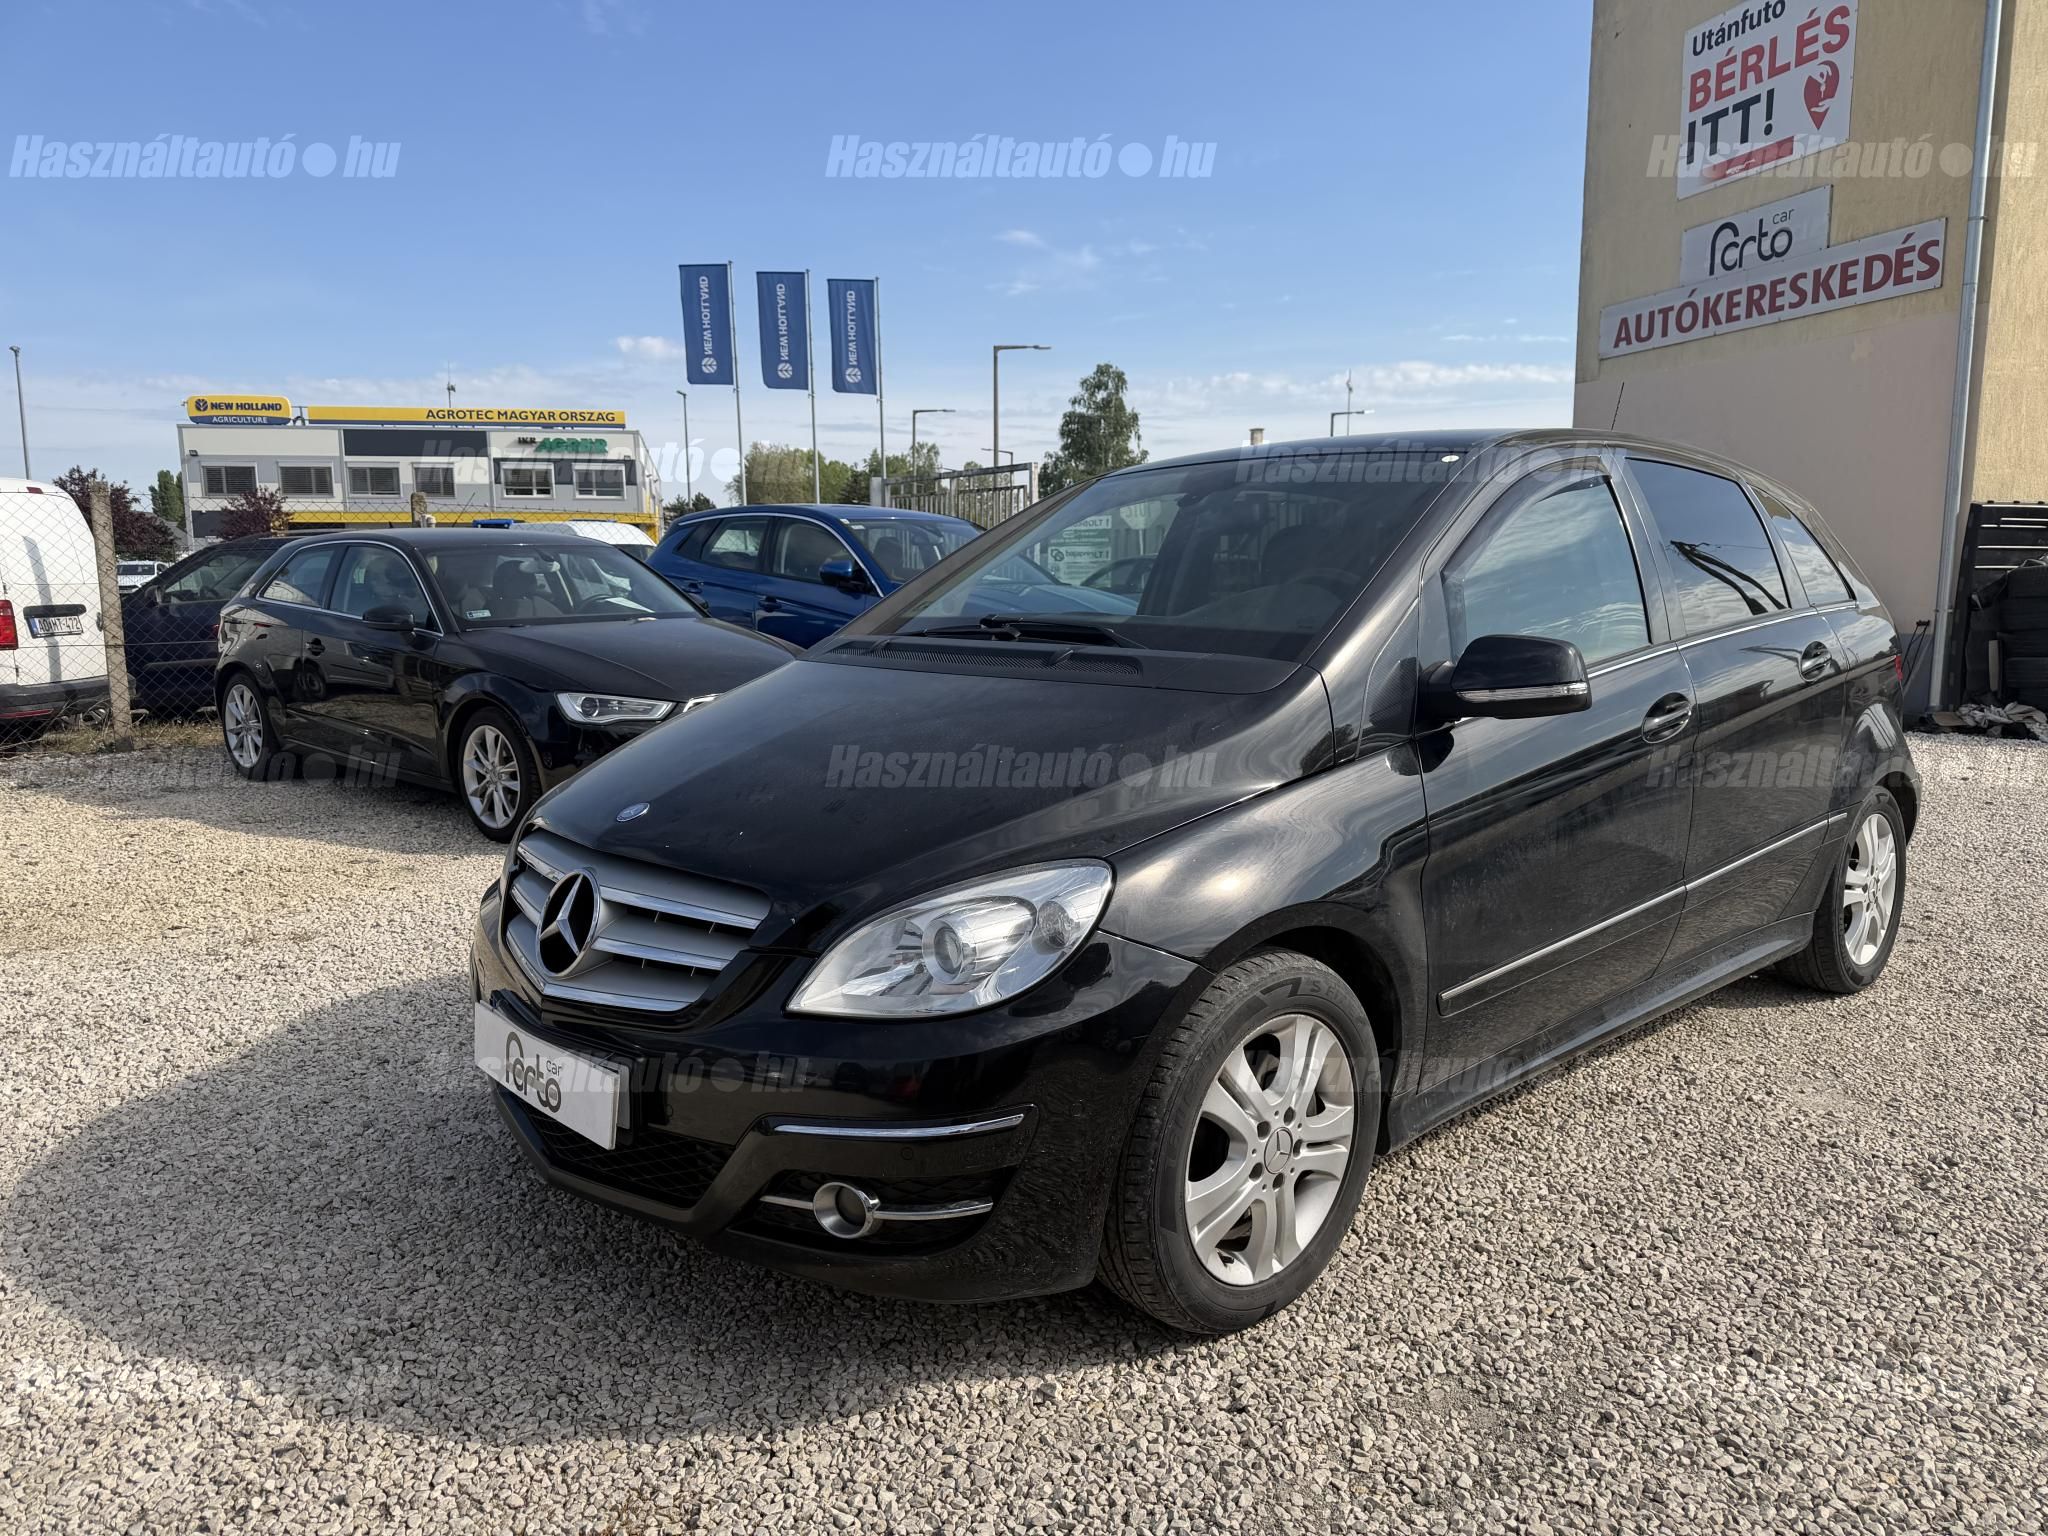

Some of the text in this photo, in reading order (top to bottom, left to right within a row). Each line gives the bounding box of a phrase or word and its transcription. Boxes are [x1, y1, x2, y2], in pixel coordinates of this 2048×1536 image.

[1689, 5, 1850, 112] BÉRLÉS
[1686, 88, 1775, 165] ITT!
[1772, 208, 1795, 225] car
[1612, 231, 1941, 349] AUTÓKERESKEDÉS
[210, 402, 282, 411] NEW HOLLAND
[212, 416, 268, 424] AGRICULTURE
[426, 409, 616, 422] AGROTEC MAGYAR ORSZÁG
[545, 1059, 562, 1077] car
